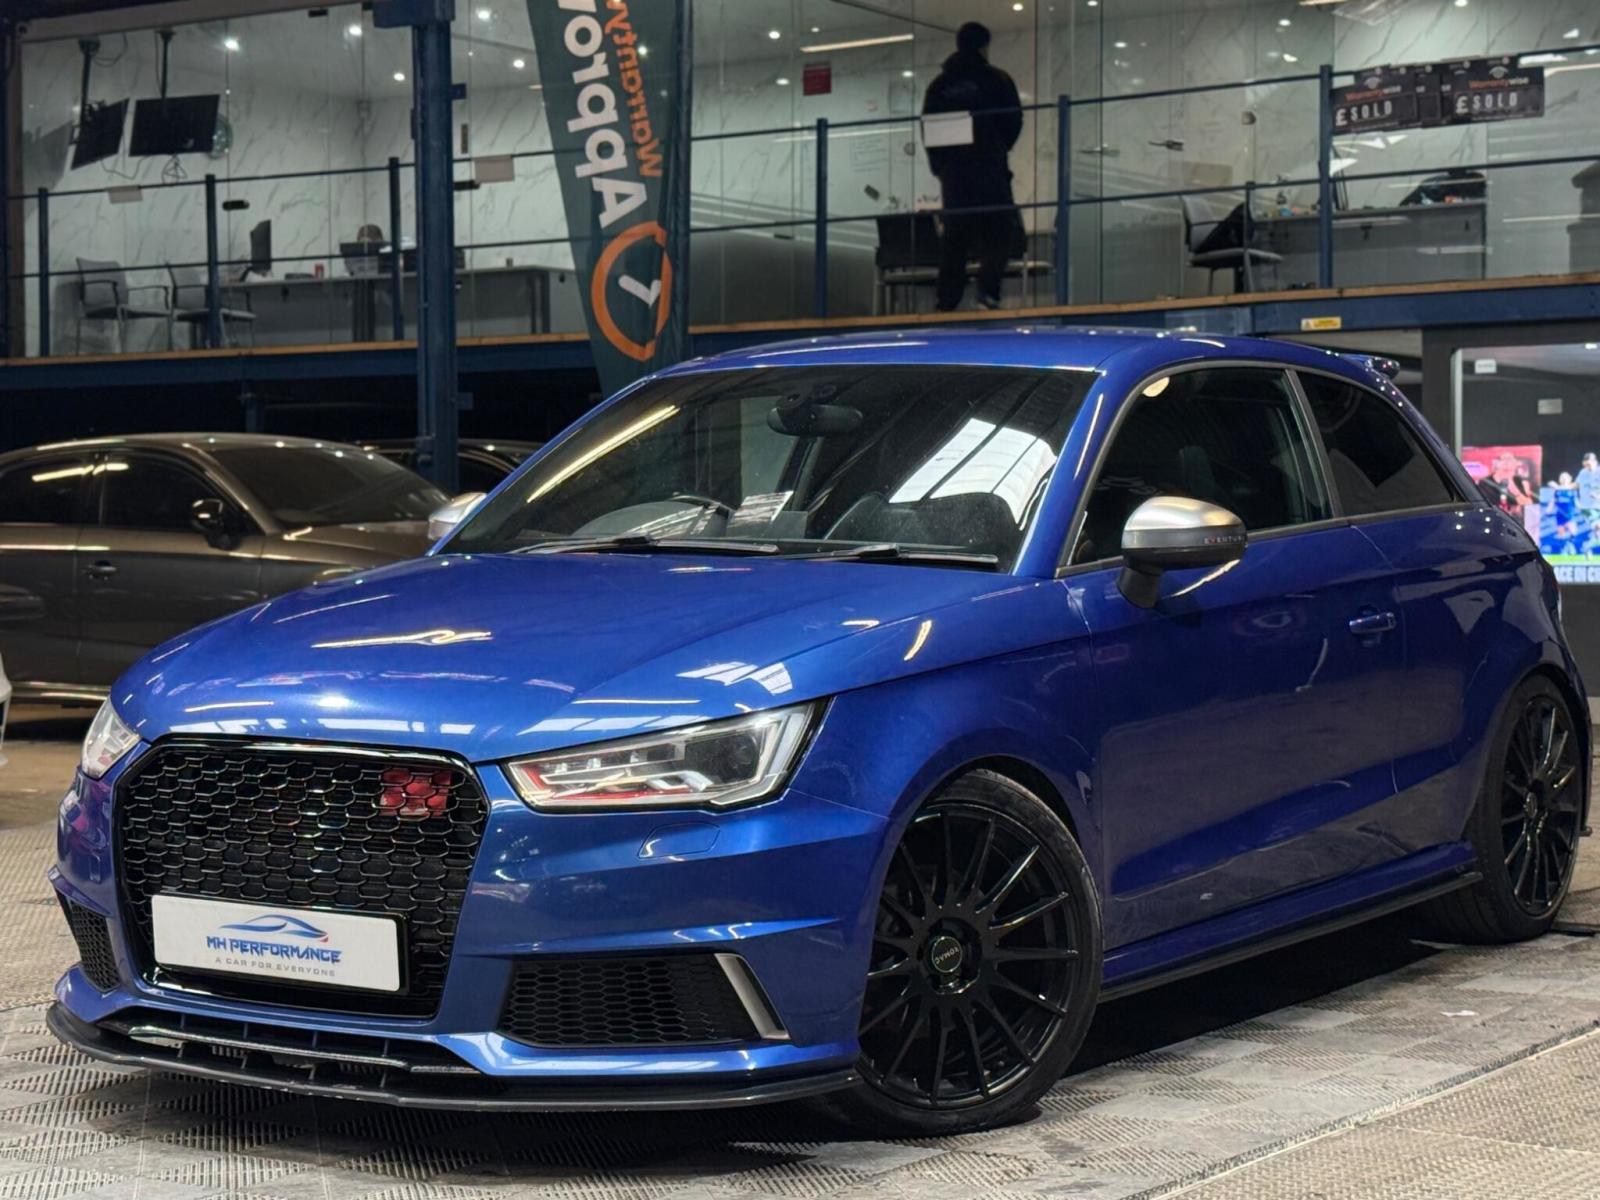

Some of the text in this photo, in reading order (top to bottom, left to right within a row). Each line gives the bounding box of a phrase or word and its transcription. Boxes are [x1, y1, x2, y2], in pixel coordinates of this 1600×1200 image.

[206, 935, 342, 963] MH PERFORMANCE
[226, 957, 249, 967] CAR
[251, 960, 273, 970] FOR
